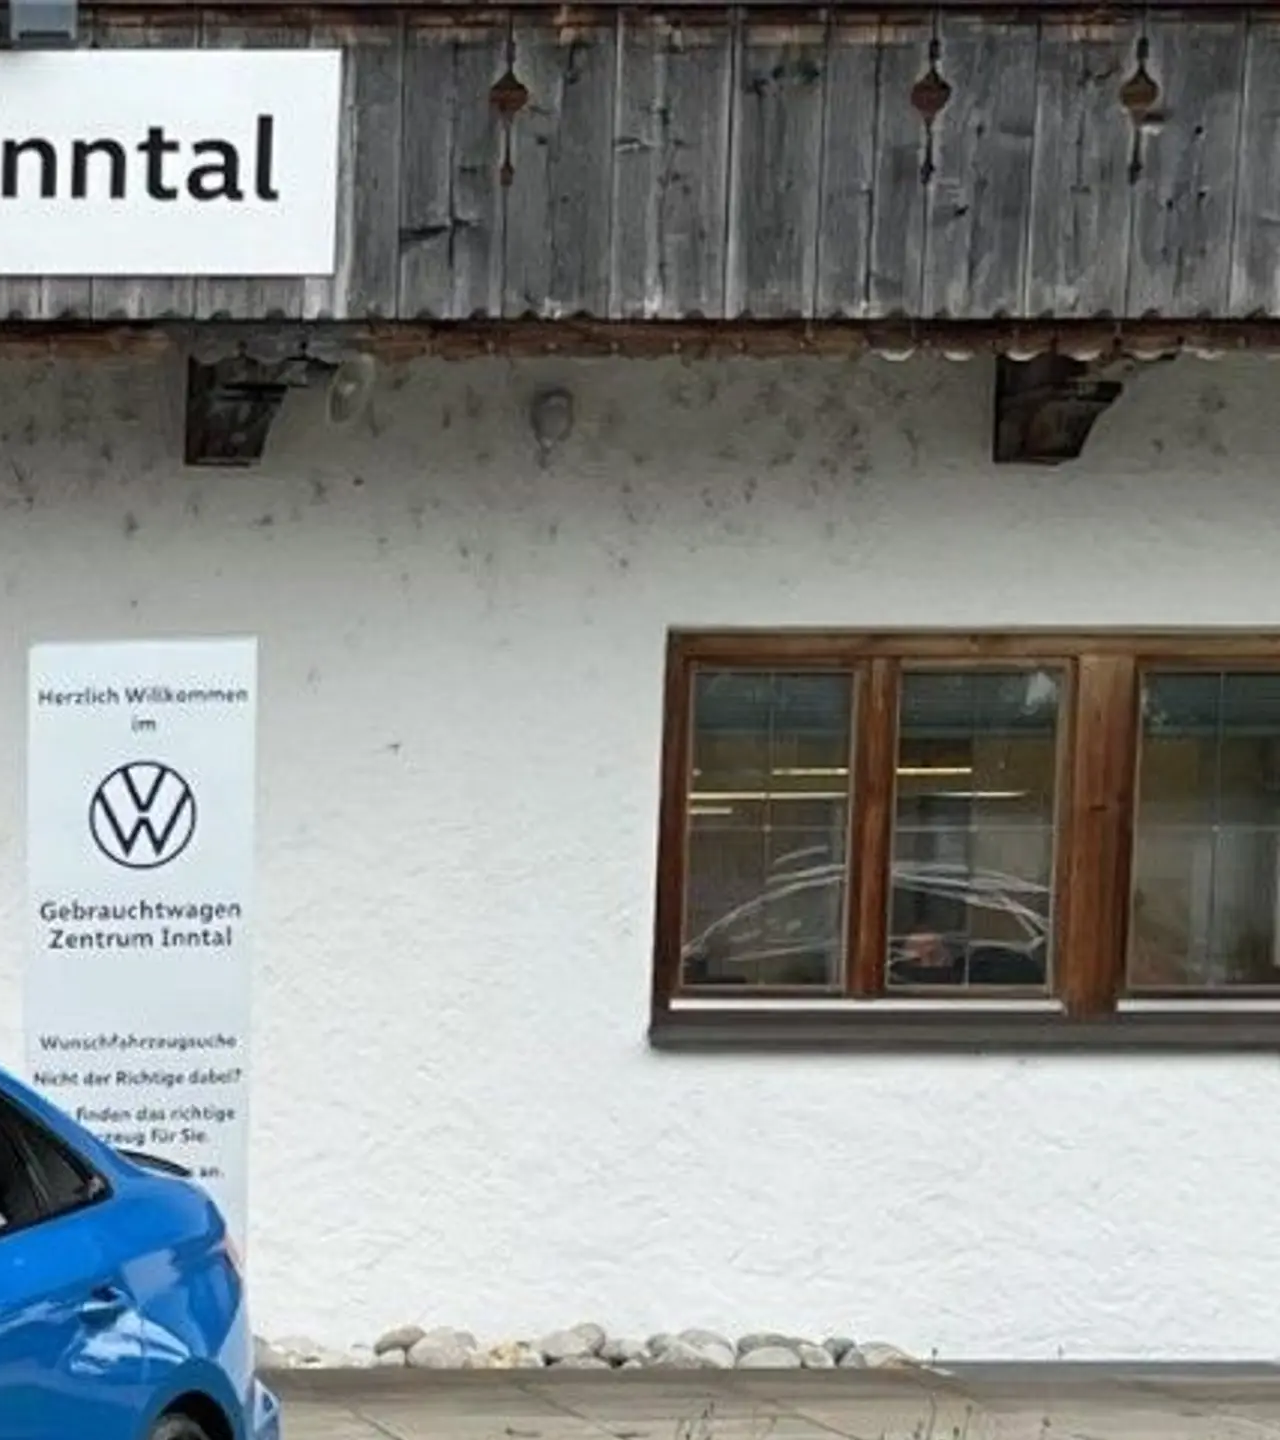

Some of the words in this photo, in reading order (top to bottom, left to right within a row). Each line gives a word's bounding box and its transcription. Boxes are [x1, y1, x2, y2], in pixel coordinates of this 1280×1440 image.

[38, 687, 119, 705] Herzlich
[125, 686, 248, 704] Willkommen
[131, 717, 156, 732] im
[40, 900, 242, 924] Gebrauchtwagen
[48, 929, 153, 950] Zentrum
[161, 926, 232, 947] Inntal
[40, 1033, 237, 1051] Wunschfahrzeugsuche
[34, 1071, 78, 1086] Nicht
[83, 1071, 111, 1086] der
[116, 1070, 185, 1088] Richtige
[188, 1068, 243, 1085] dabei?
[76, 1106, 131, 1122] finden
[135, 1106, 165, 1121] das
[170, 1104, 235, 1123] richtige
[151, 1128, 177, 1142] für
